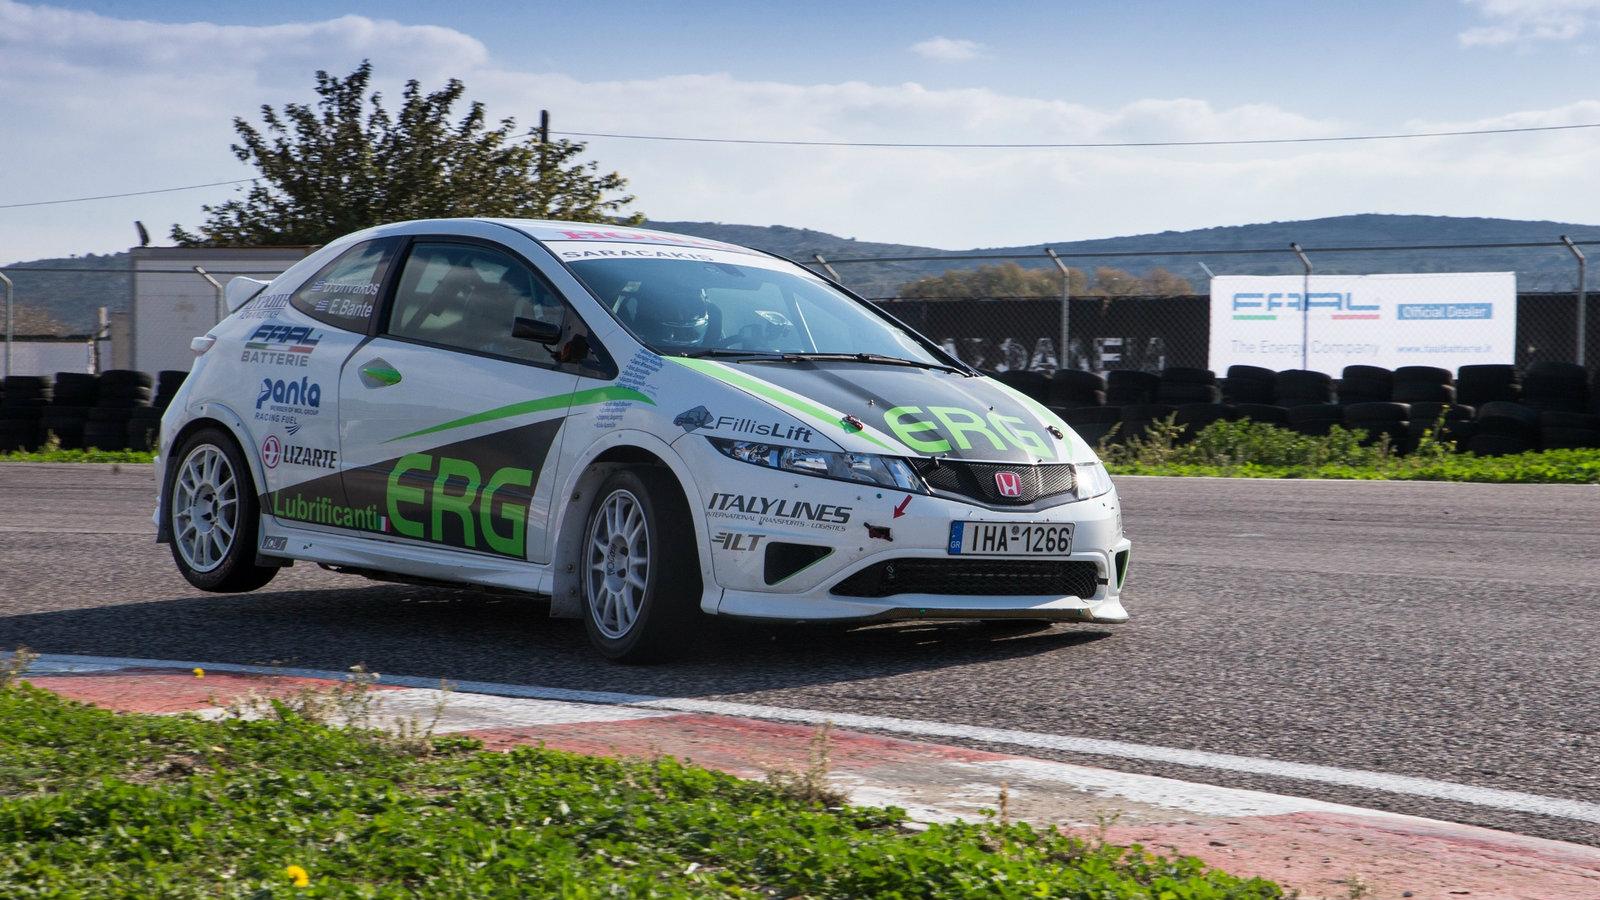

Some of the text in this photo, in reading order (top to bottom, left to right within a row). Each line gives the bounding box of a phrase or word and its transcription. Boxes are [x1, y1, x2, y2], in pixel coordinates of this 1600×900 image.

[562, 249, 714, 262] SARACAKIS
[328, 299, 373, 317] E.Bante
[1403, 305, 1488, 318] Official Dealer
[1232, 340, 1256, 354] The
[1310, 340, 1379, 357] Company
[241, 350, 310, 367] BATTERIE
[255, 412, 298, 424] RACING FUEL
[715, 416, 813, 444] FillisLift
[883, 406, 1056, 459] ERG
[283, 444, 338, 469] LIZARTE
[272, 490, 378, 531] Lubrificanti
[386, 453, 534, 558] ERG
[708, 492, 853, 524] ITALYLINES
[759, 515, 805, 528] TRANSPORTS
[810, 523, 847, 532] LOGISTICS
[950, 540, 961, 549] GR
